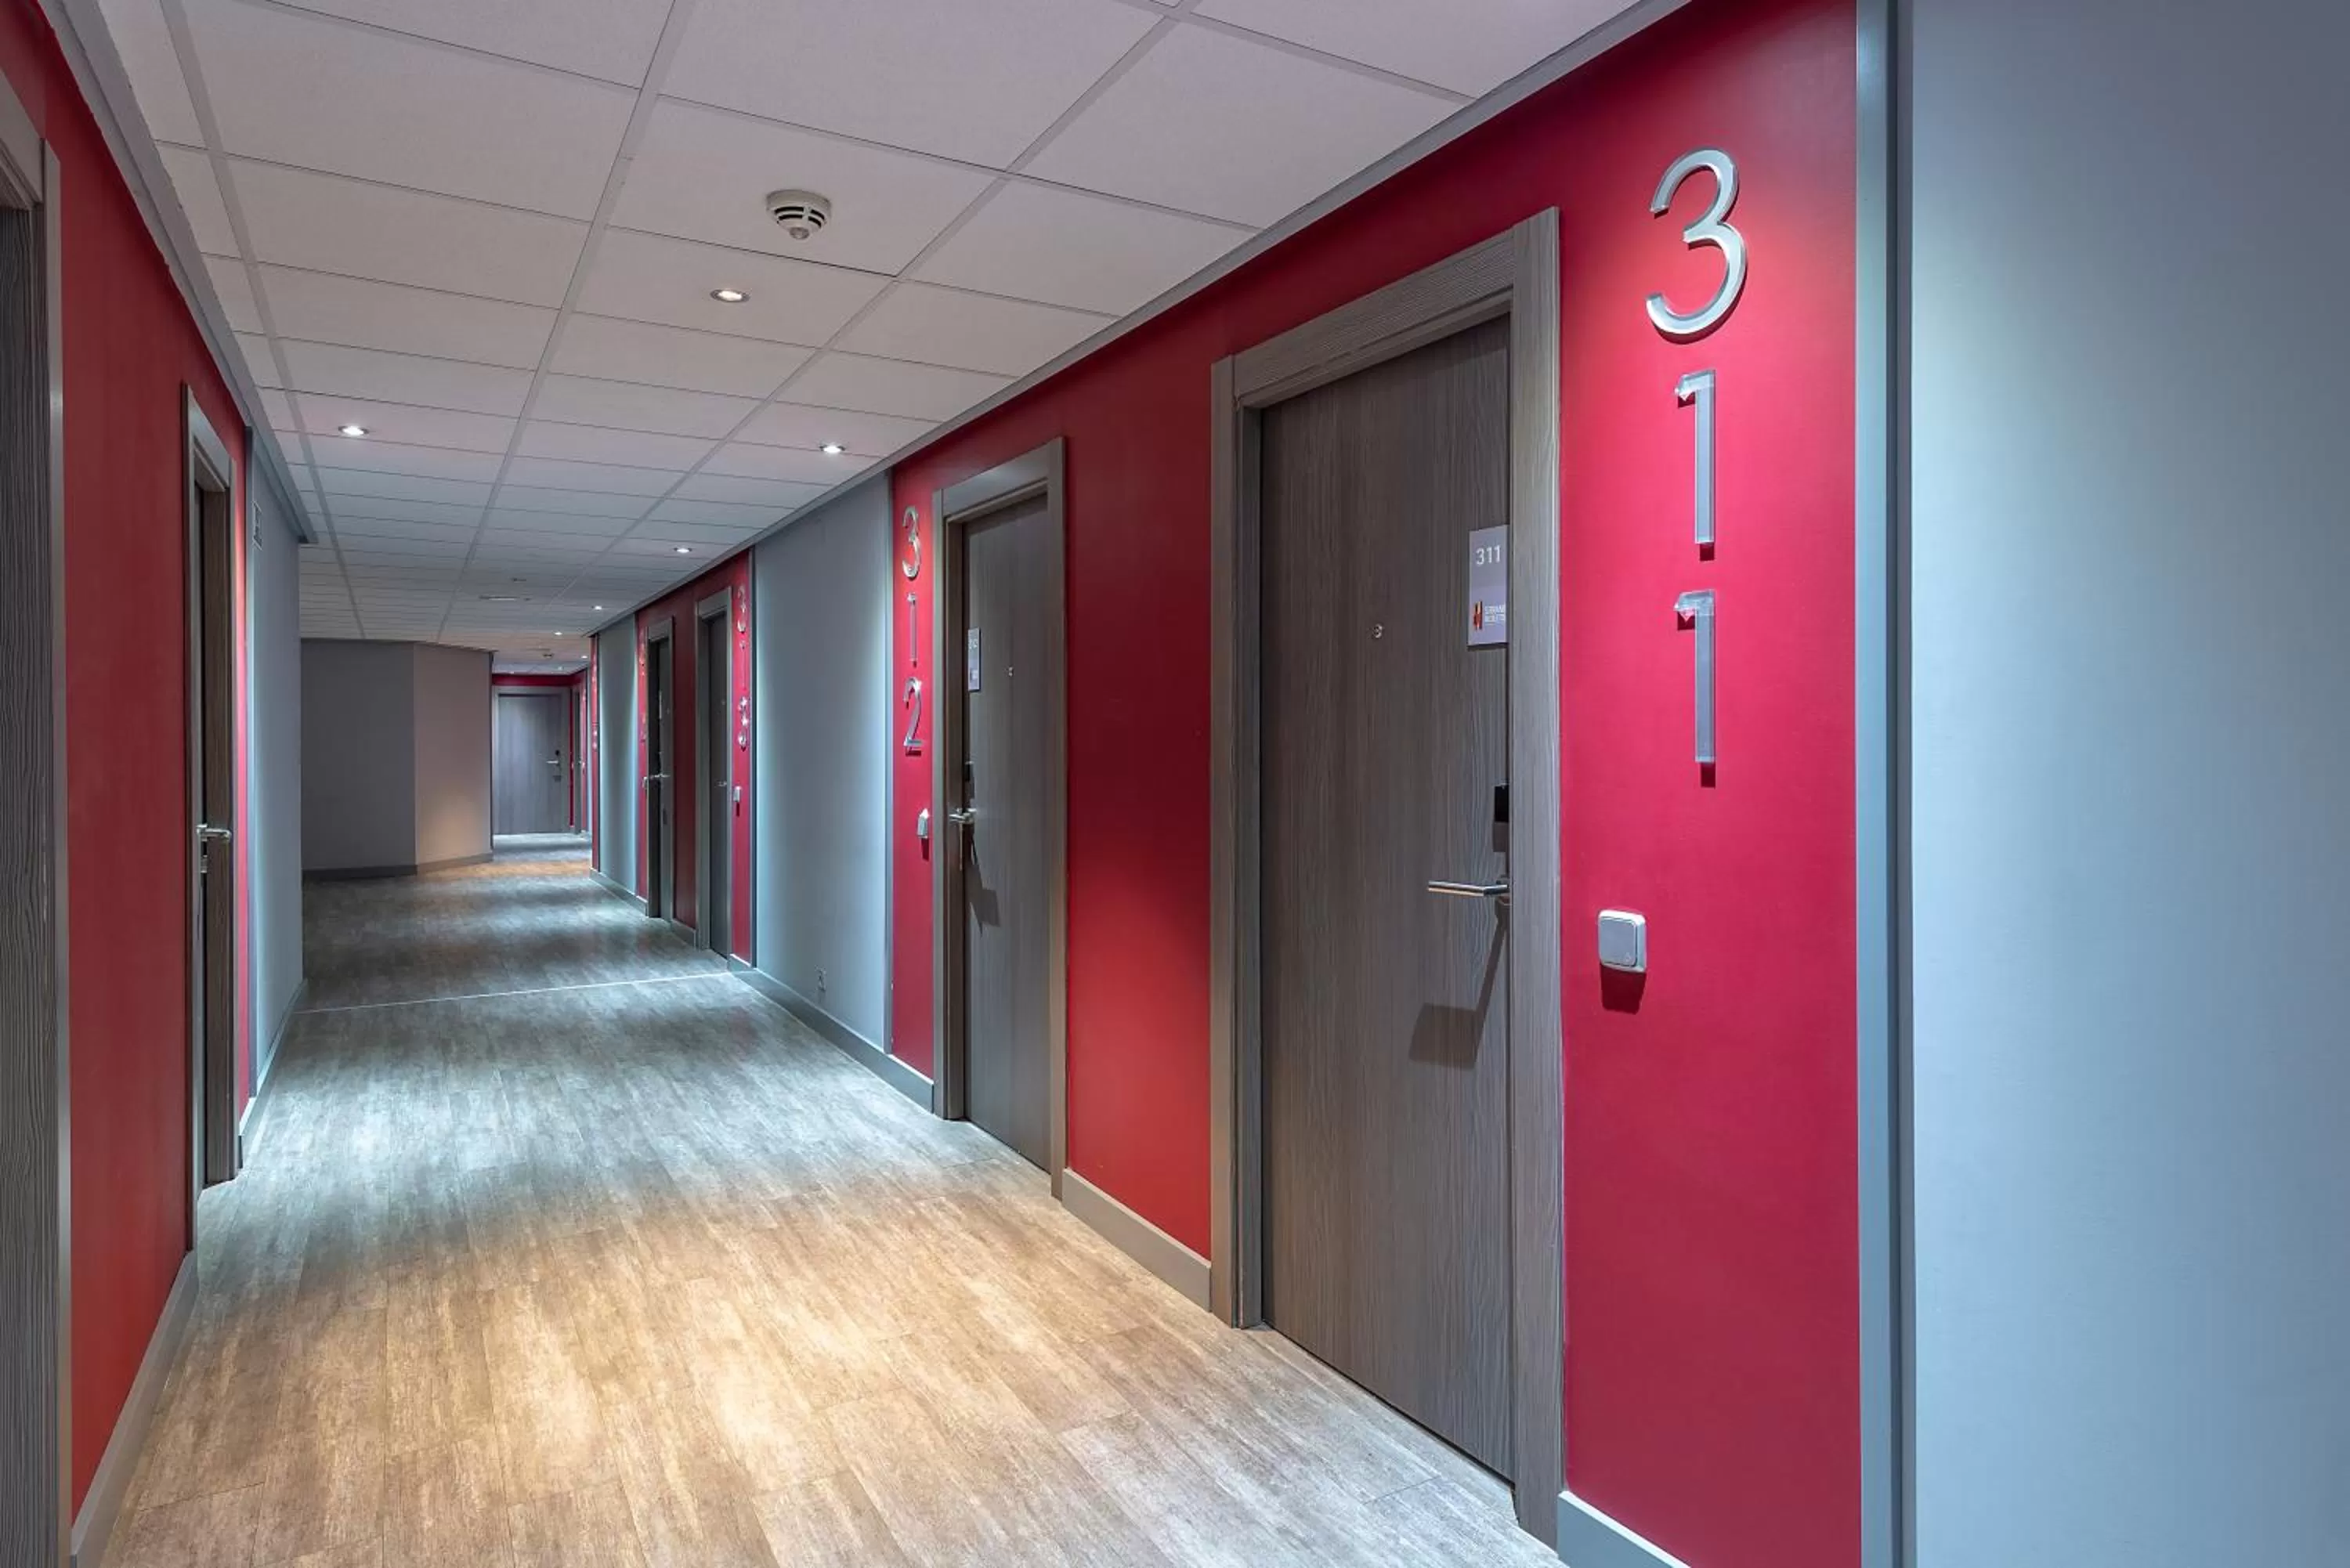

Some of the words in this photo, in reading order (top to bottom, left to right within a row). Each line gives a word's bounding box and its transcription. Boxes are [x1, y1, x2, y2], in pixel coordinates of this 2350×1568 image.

[1475, 544, 1502, 565] 311
[1646, 146, 1748, 764] 311
[902, 506, 924, 746] 312
